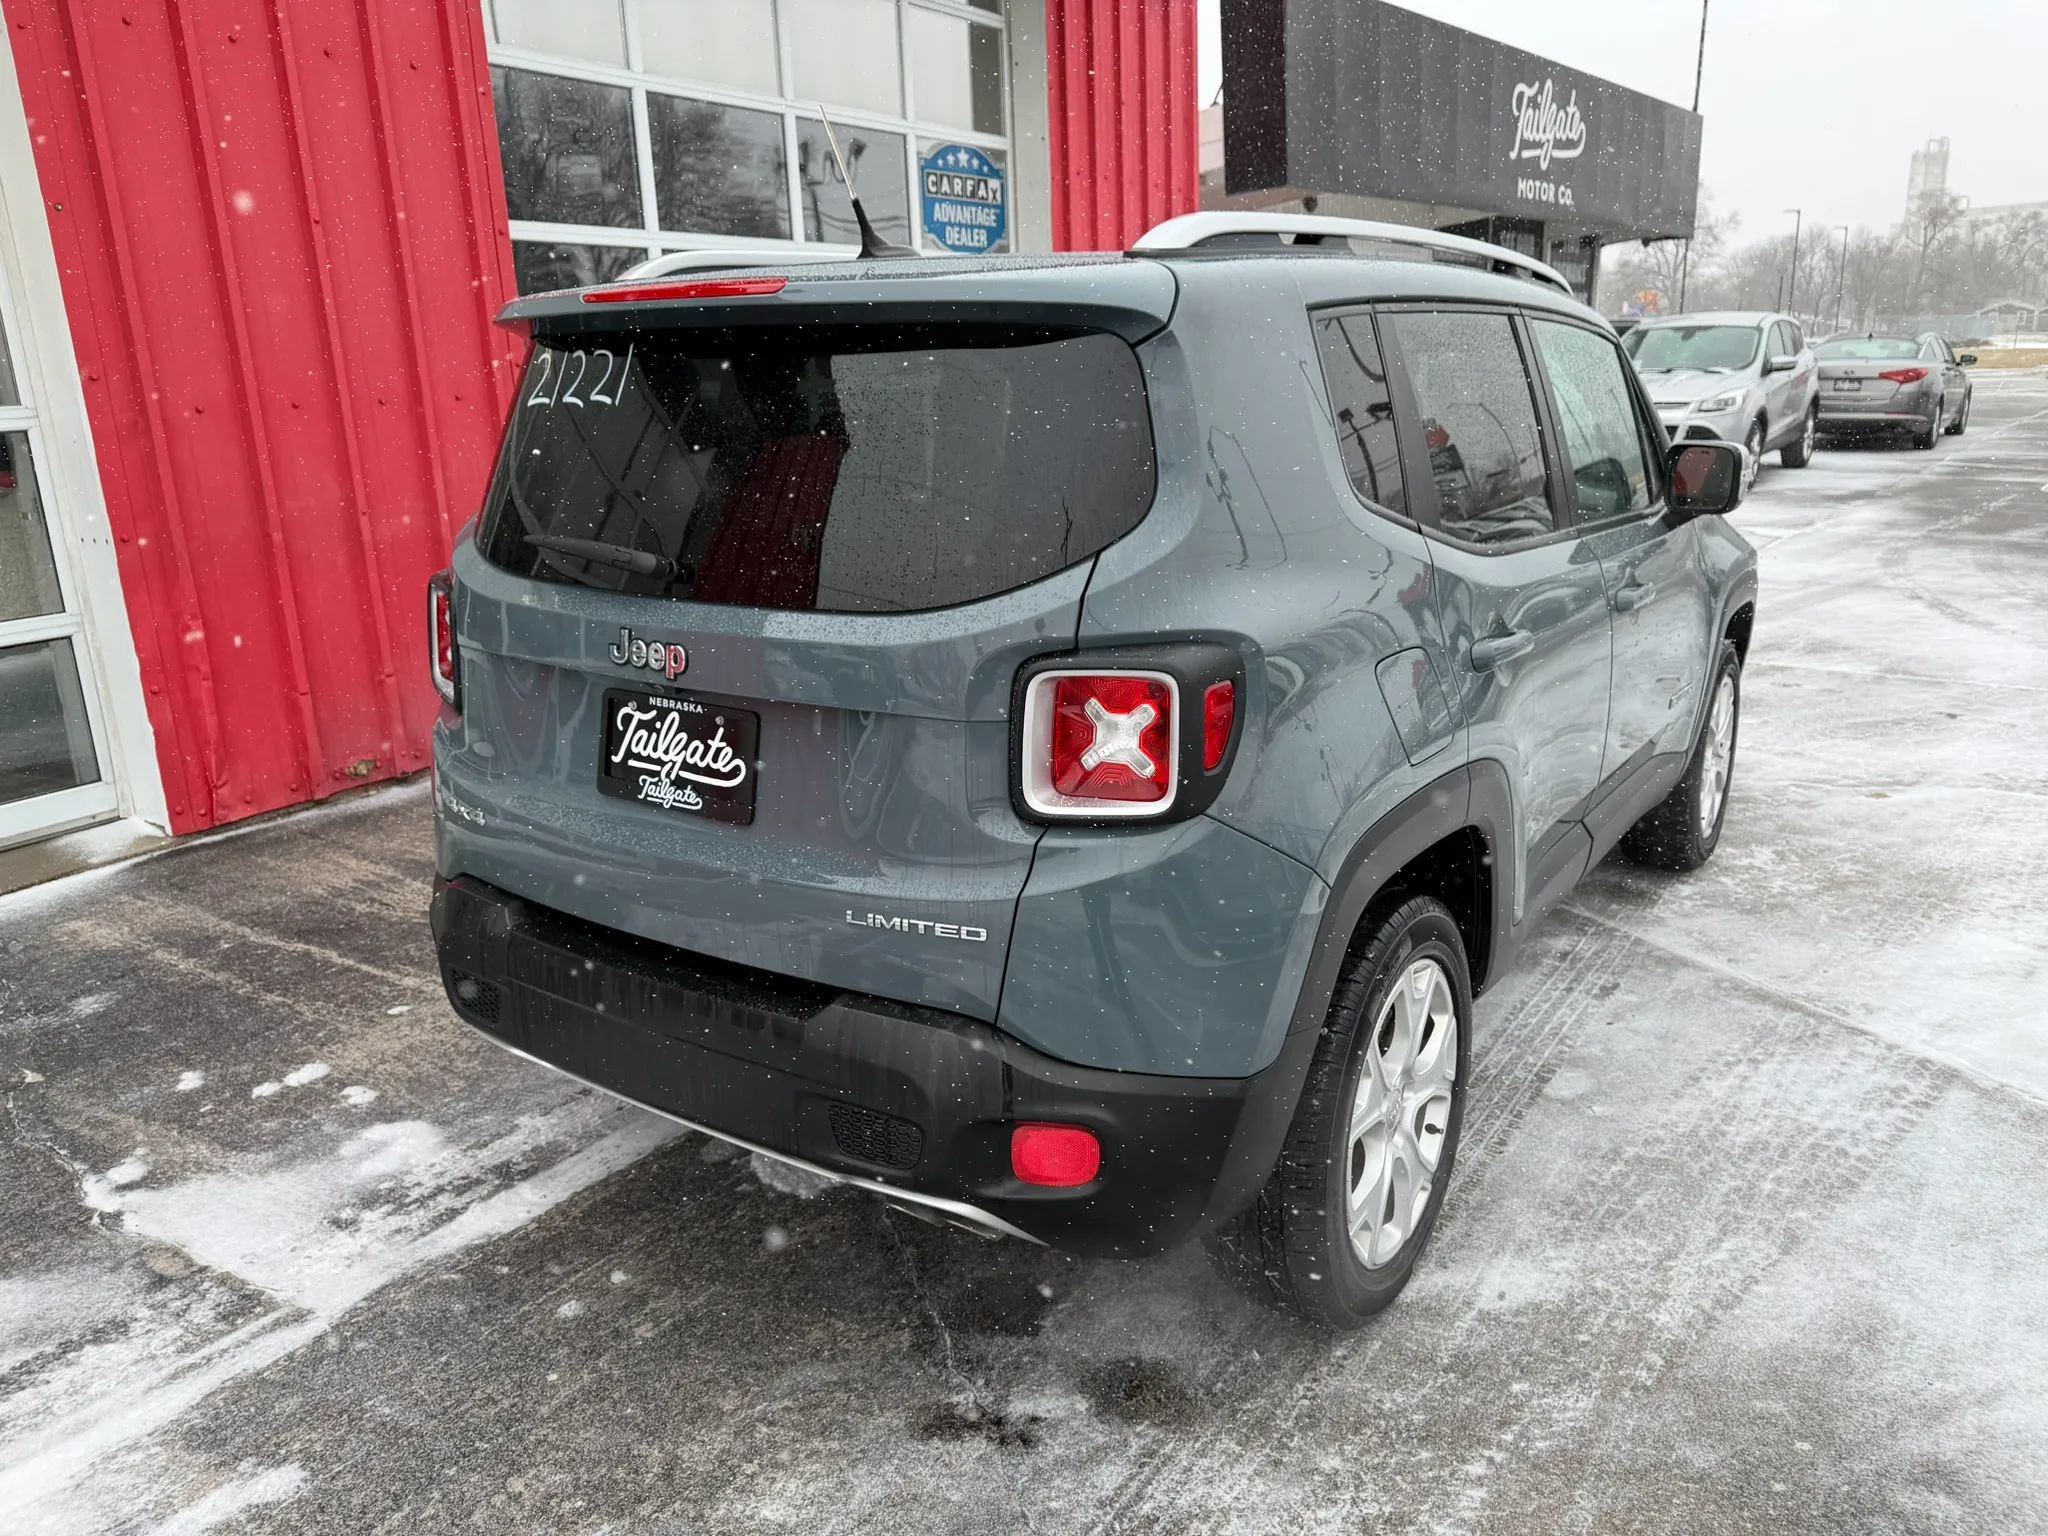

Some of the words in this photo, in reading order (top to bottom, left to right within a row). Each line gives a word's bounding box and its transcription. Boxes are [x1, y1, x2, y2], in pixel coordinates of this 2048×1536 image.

[1508, 78, 1587, 171] Tailgate
[926, 173, 1000, 204] CARFAX
[1516, 176, 1556, 204] MOTOR
[933, 201, 998, 228] ADVANTAGE
[944, 225, 988, 249] DEALER
[608, 626, 689, 682] Jeep
[648, 696, 704, 714] NEBRASKA
[611, 705, 747, 788] Tailgate
[637, 774, 703, 810] Tailgate
[845, 909, 988, 942] LIMITED
